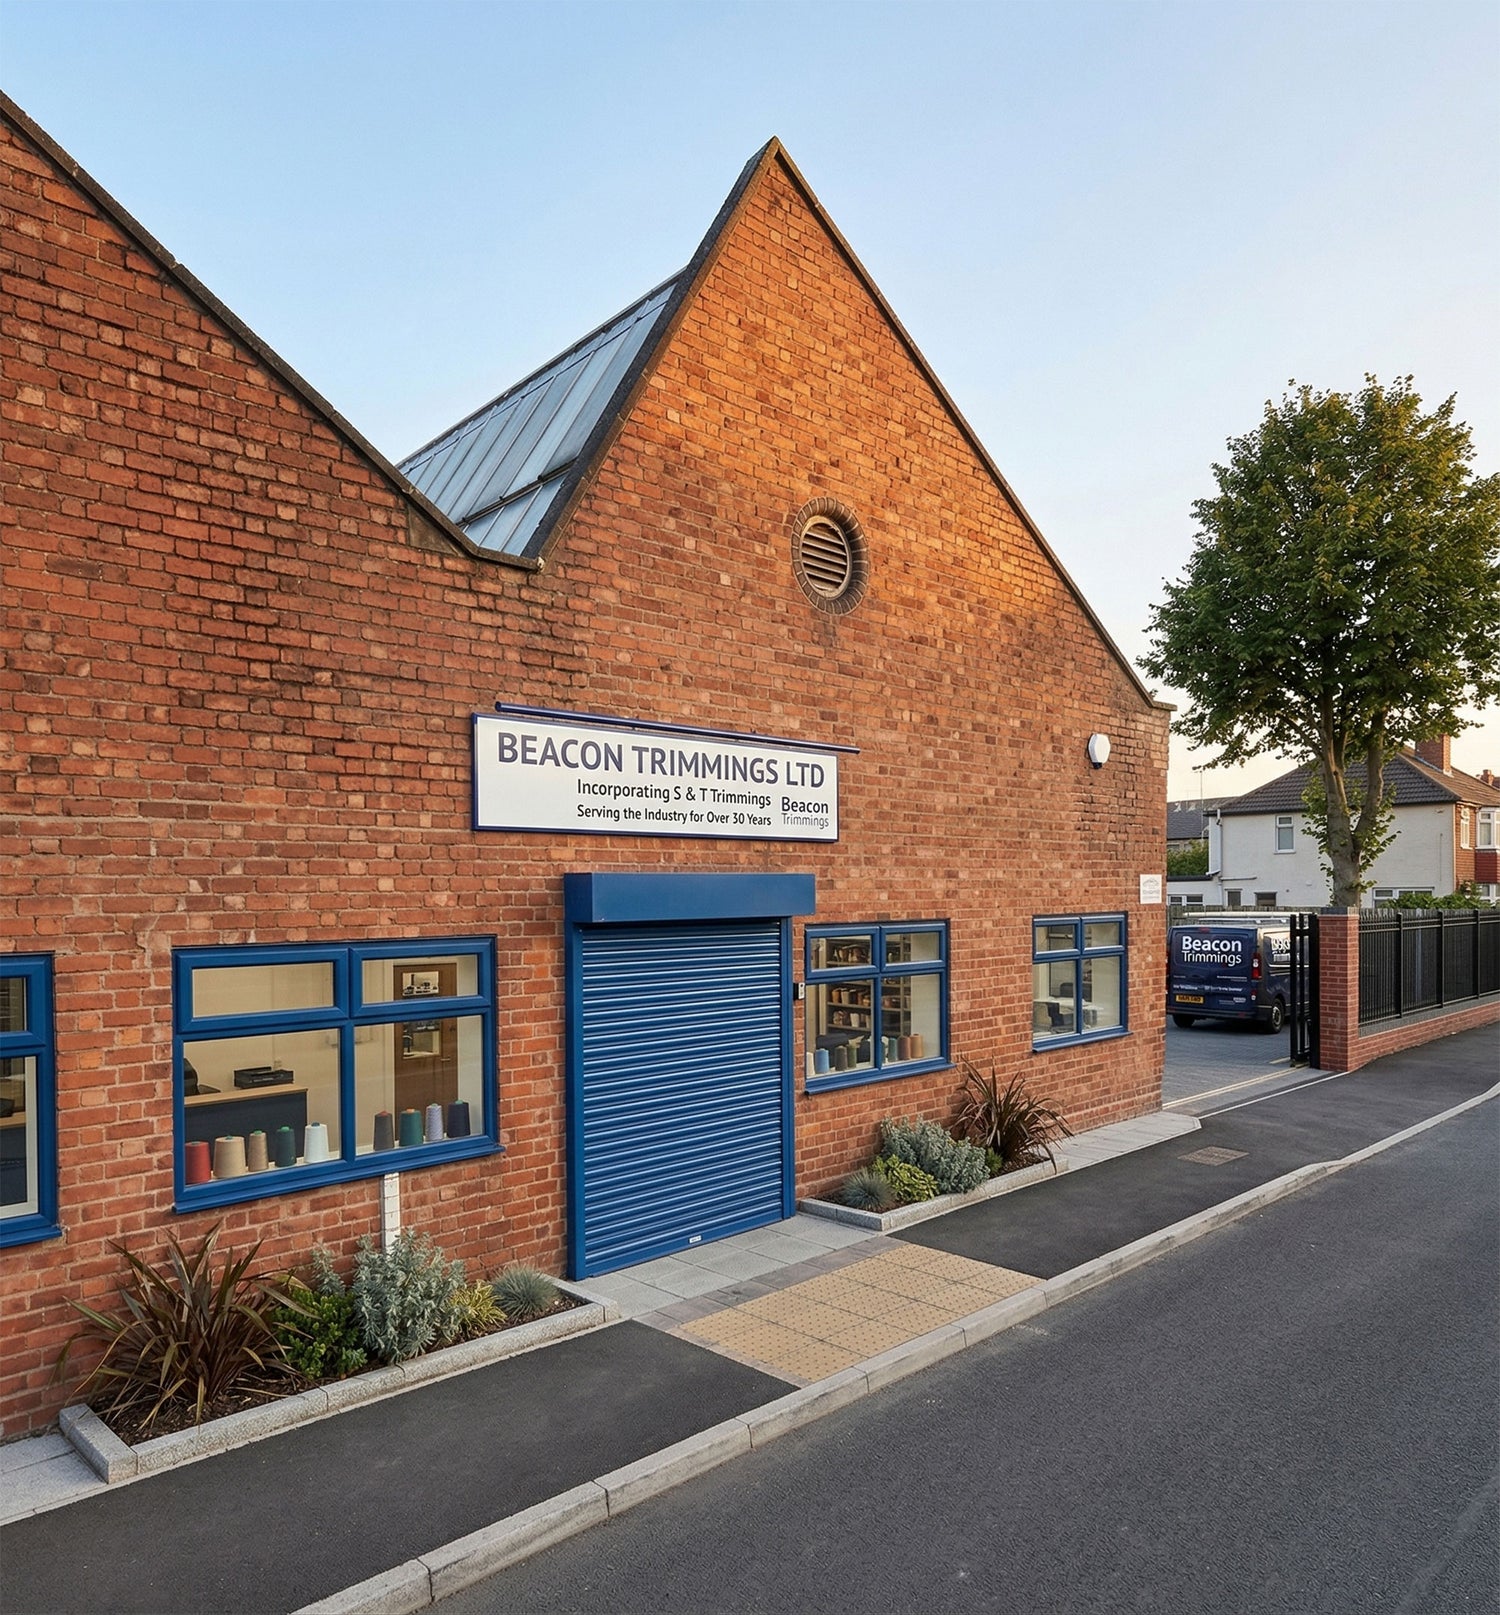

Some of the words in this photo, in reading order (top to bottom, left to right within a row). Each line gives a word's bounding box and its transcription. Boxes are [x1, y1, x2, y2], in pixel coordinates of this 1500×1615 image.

[498, 732, 623, 773] BEACON
[631, 745, 779, 785] TRIMMINGS
[786, 761, 825, 788] LTD
[577, 779, 670, 803] Incorporating
[673, 786, 682, 800] S
[685, 786, 696, 801] &
[699, 788, 708, 802] T
[710, 788, 772, 809] Trimmings
[781, 796, 829, 814] Beacon
[577, 804, 621, 822] Serving
[623, 807, 642, 820] the
[644, 808, 688, 825] Industry
[690, 811, 704, 823] for
[706, 811, 730, 824] Over
[732, 812, 745, 825] 30
[747, 813, 772, 826] Years
[781, 813, 829, 829] Trimmings
[1181, 935, 1242, 952] Beacon
[1181, 951, 1242, 967] Trimmings
